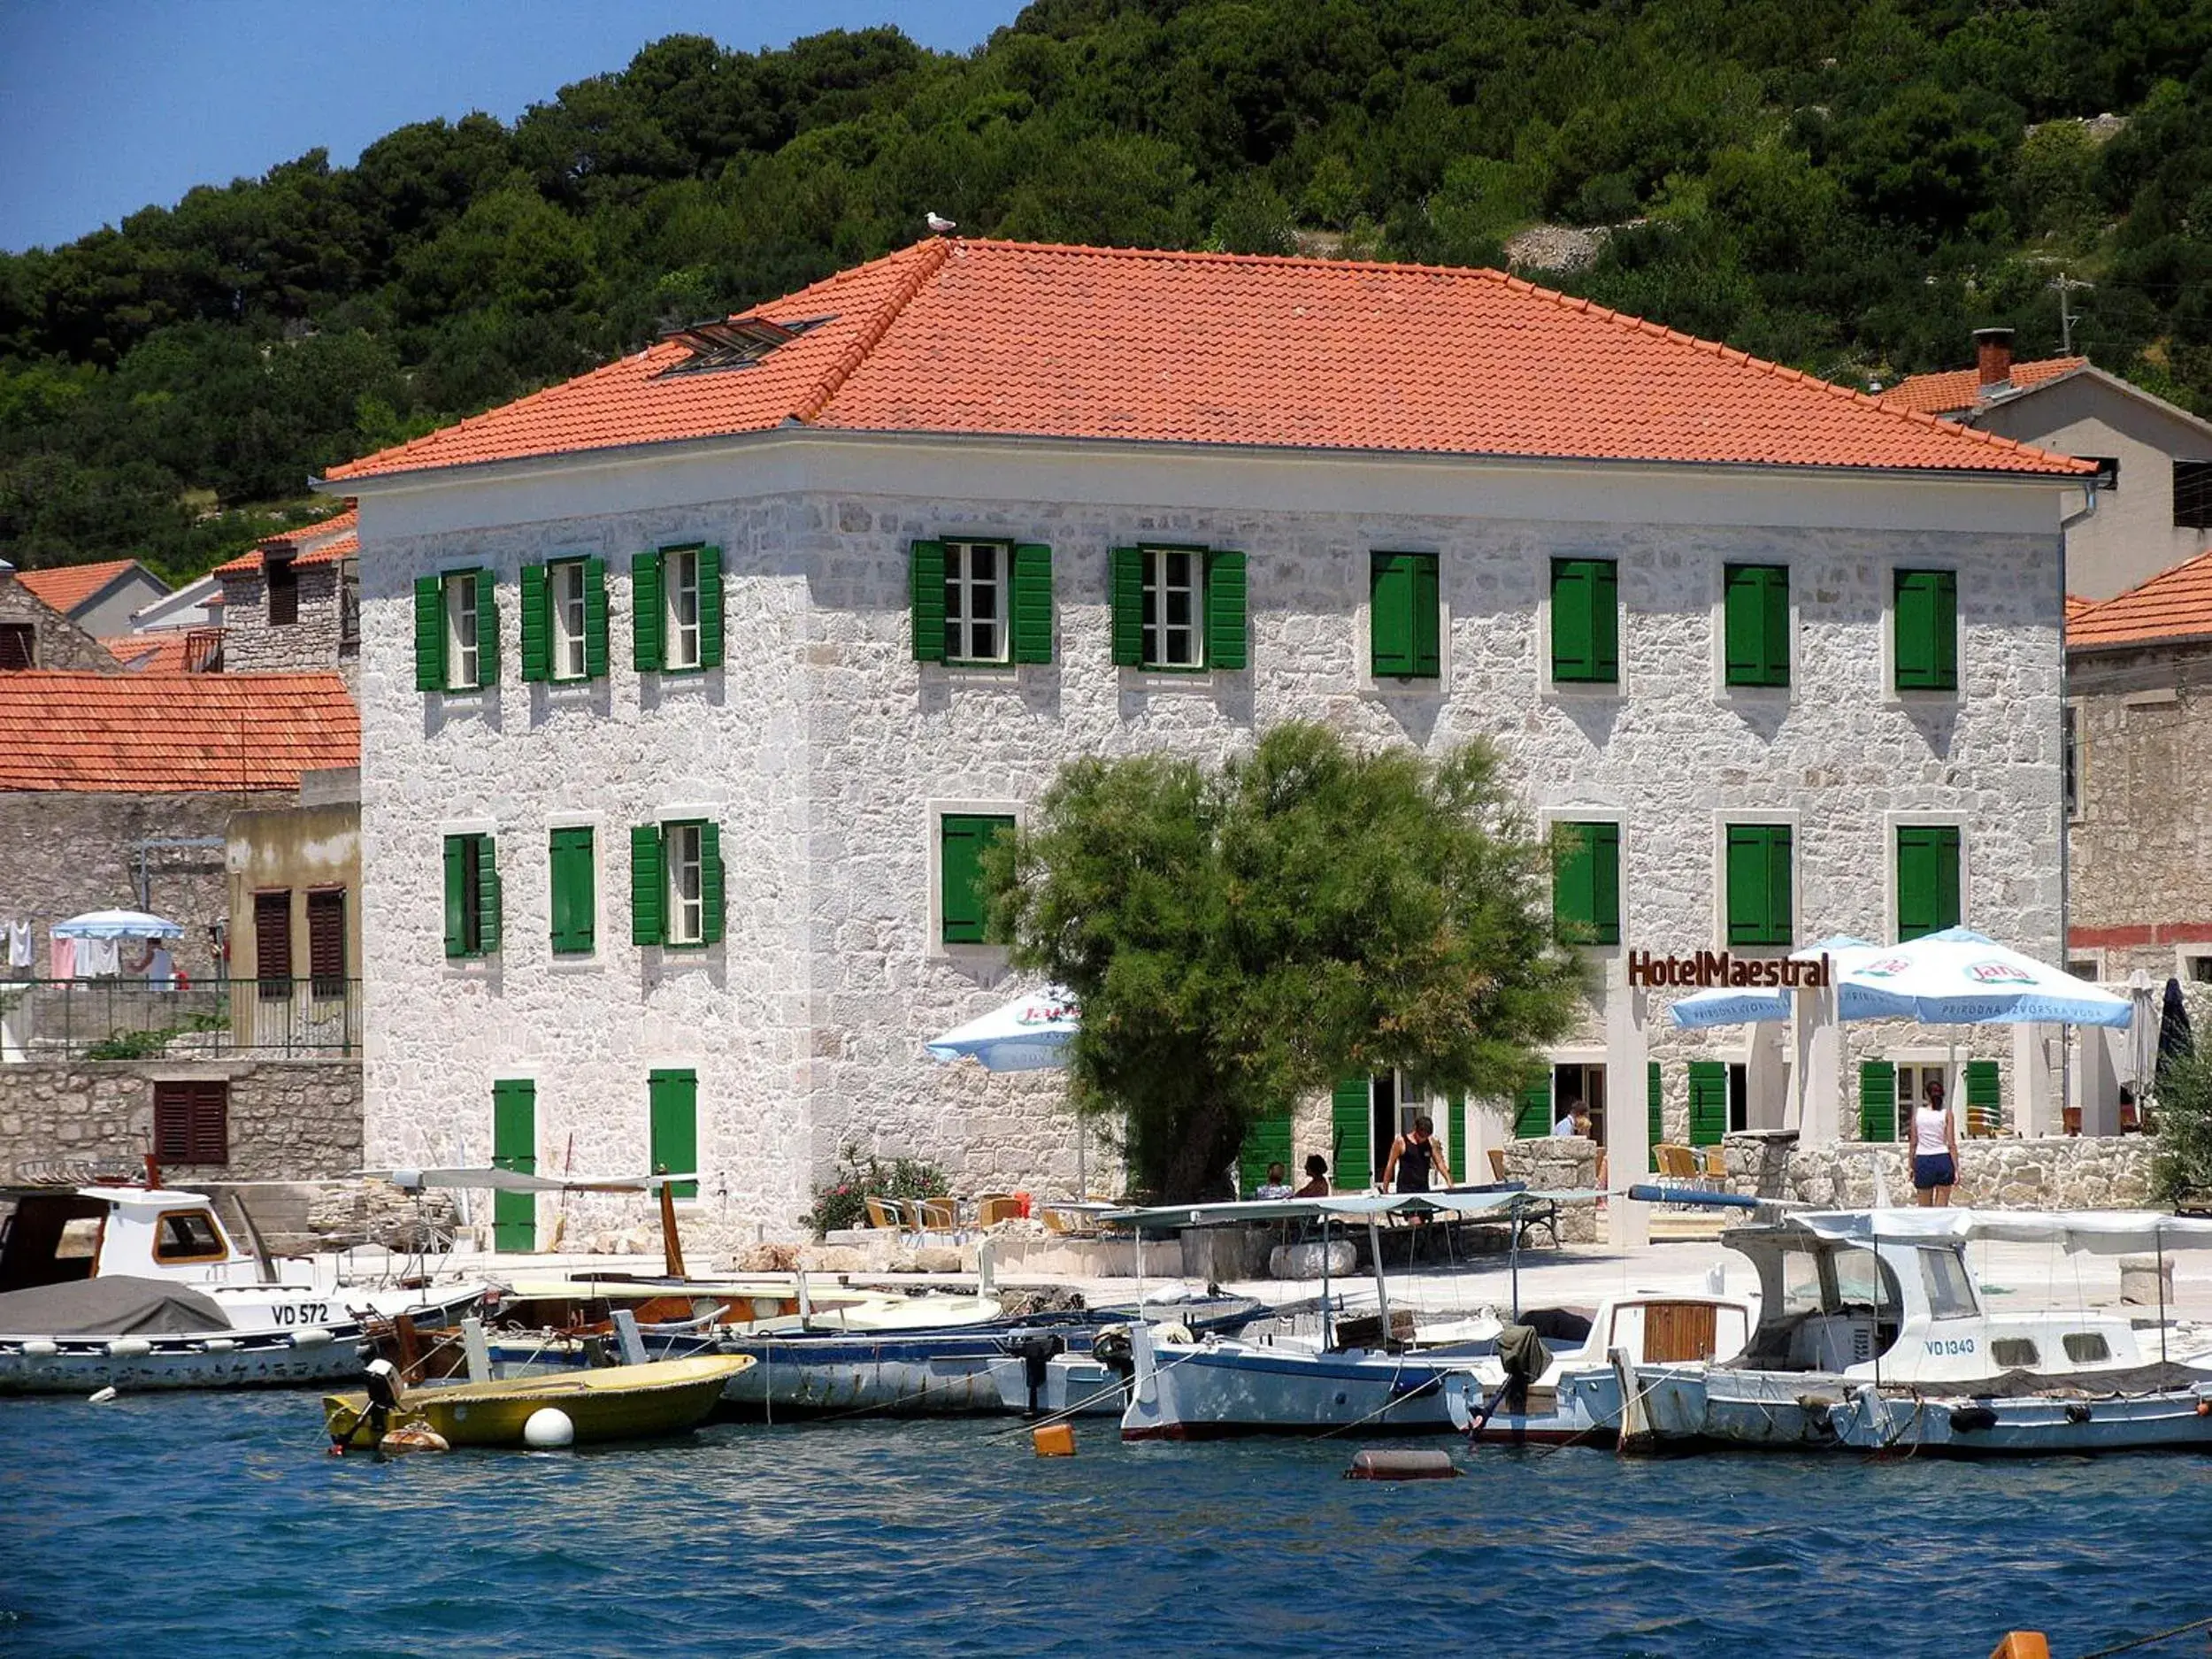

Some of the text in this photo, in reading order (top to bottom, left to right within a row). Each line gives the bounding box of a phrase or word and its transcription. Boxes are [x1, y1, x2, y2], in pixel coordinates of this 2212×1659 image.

[1941, 1004, 2001, 1015] PRIRODNA
[271, 1302, 329, 1325] VD 572
[1924, 1338, 1975, 1356] VD 1343
